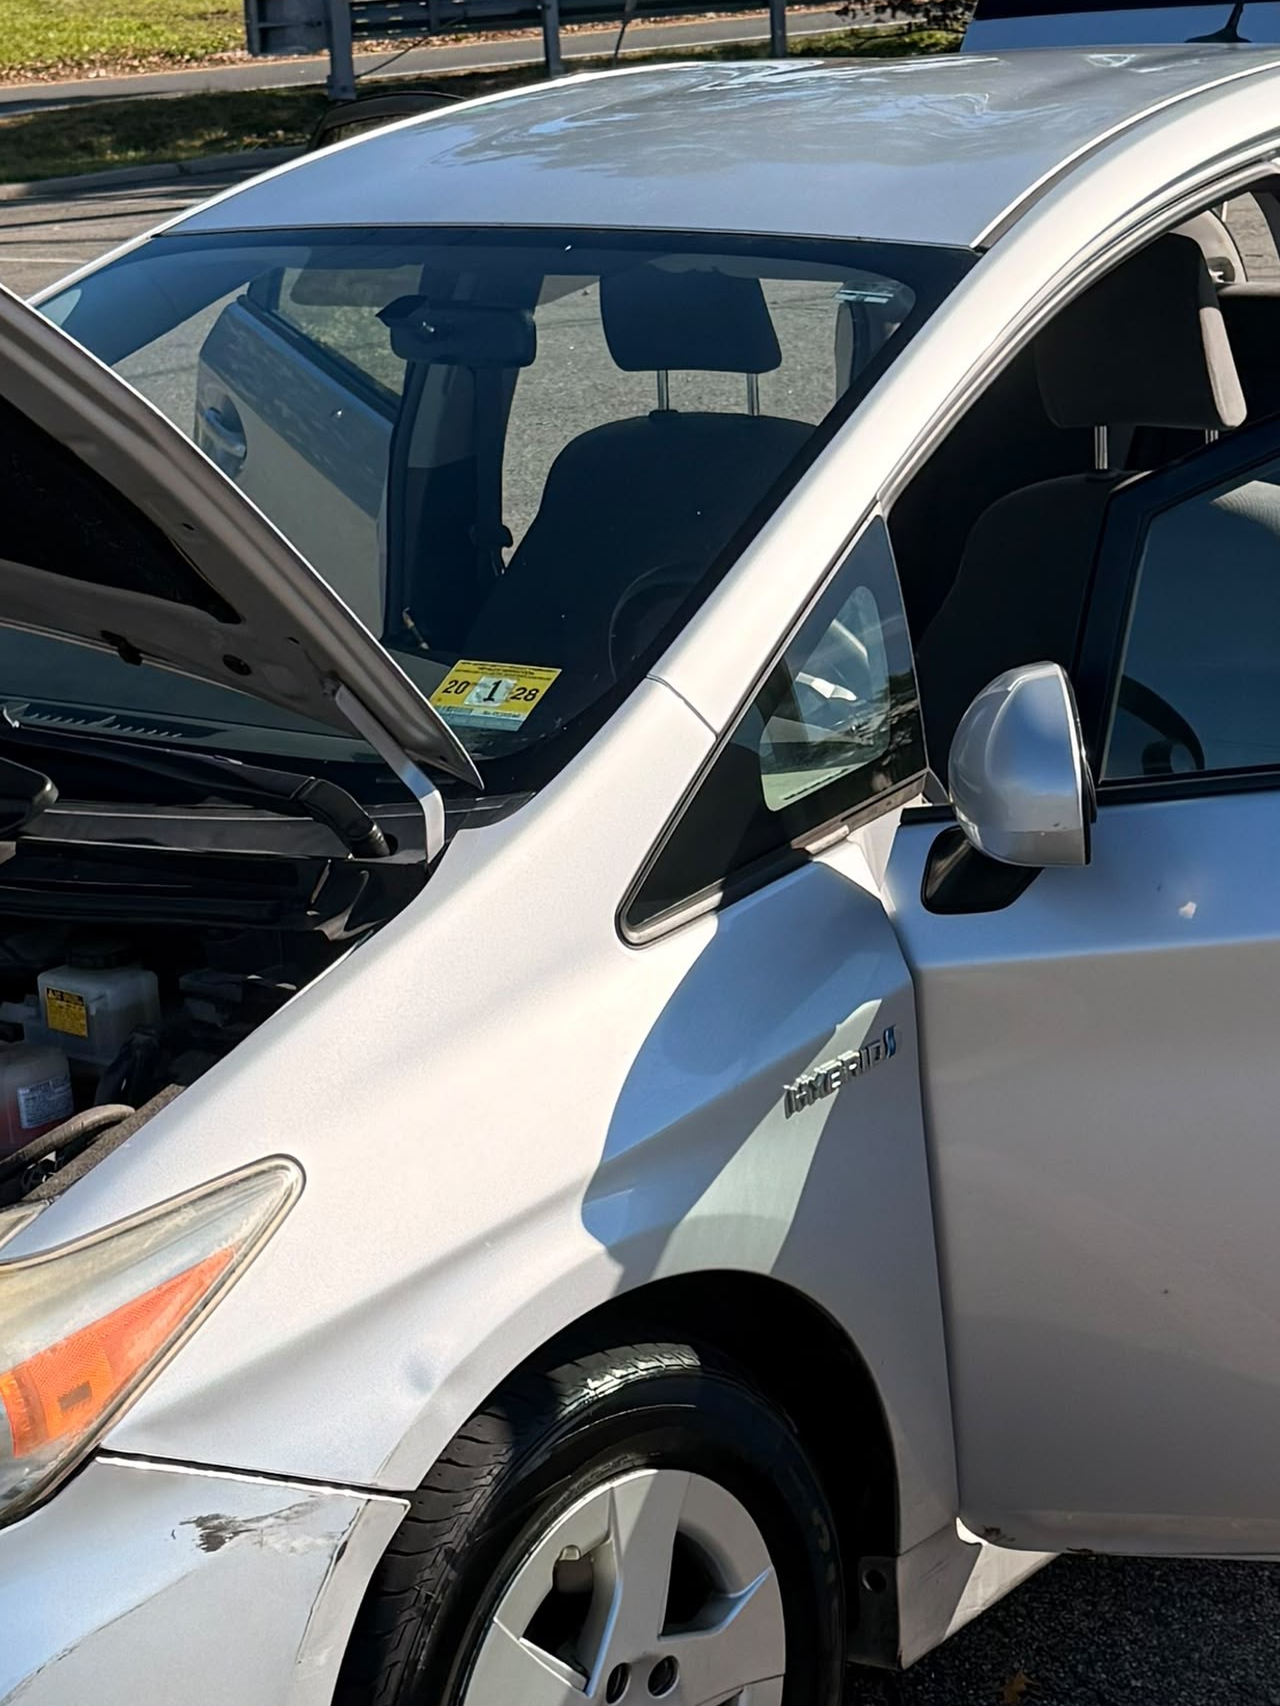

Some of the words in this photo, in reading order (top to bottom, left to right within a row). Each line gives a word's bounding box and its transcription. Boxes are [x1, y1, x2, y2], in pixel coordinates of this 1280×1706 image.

[442, 679, 470, 695] 20
[483, 679, 502, 702] 1
[510, 687, 540, 702] 28
[783, 1037, 882, 1119] HYBRID
